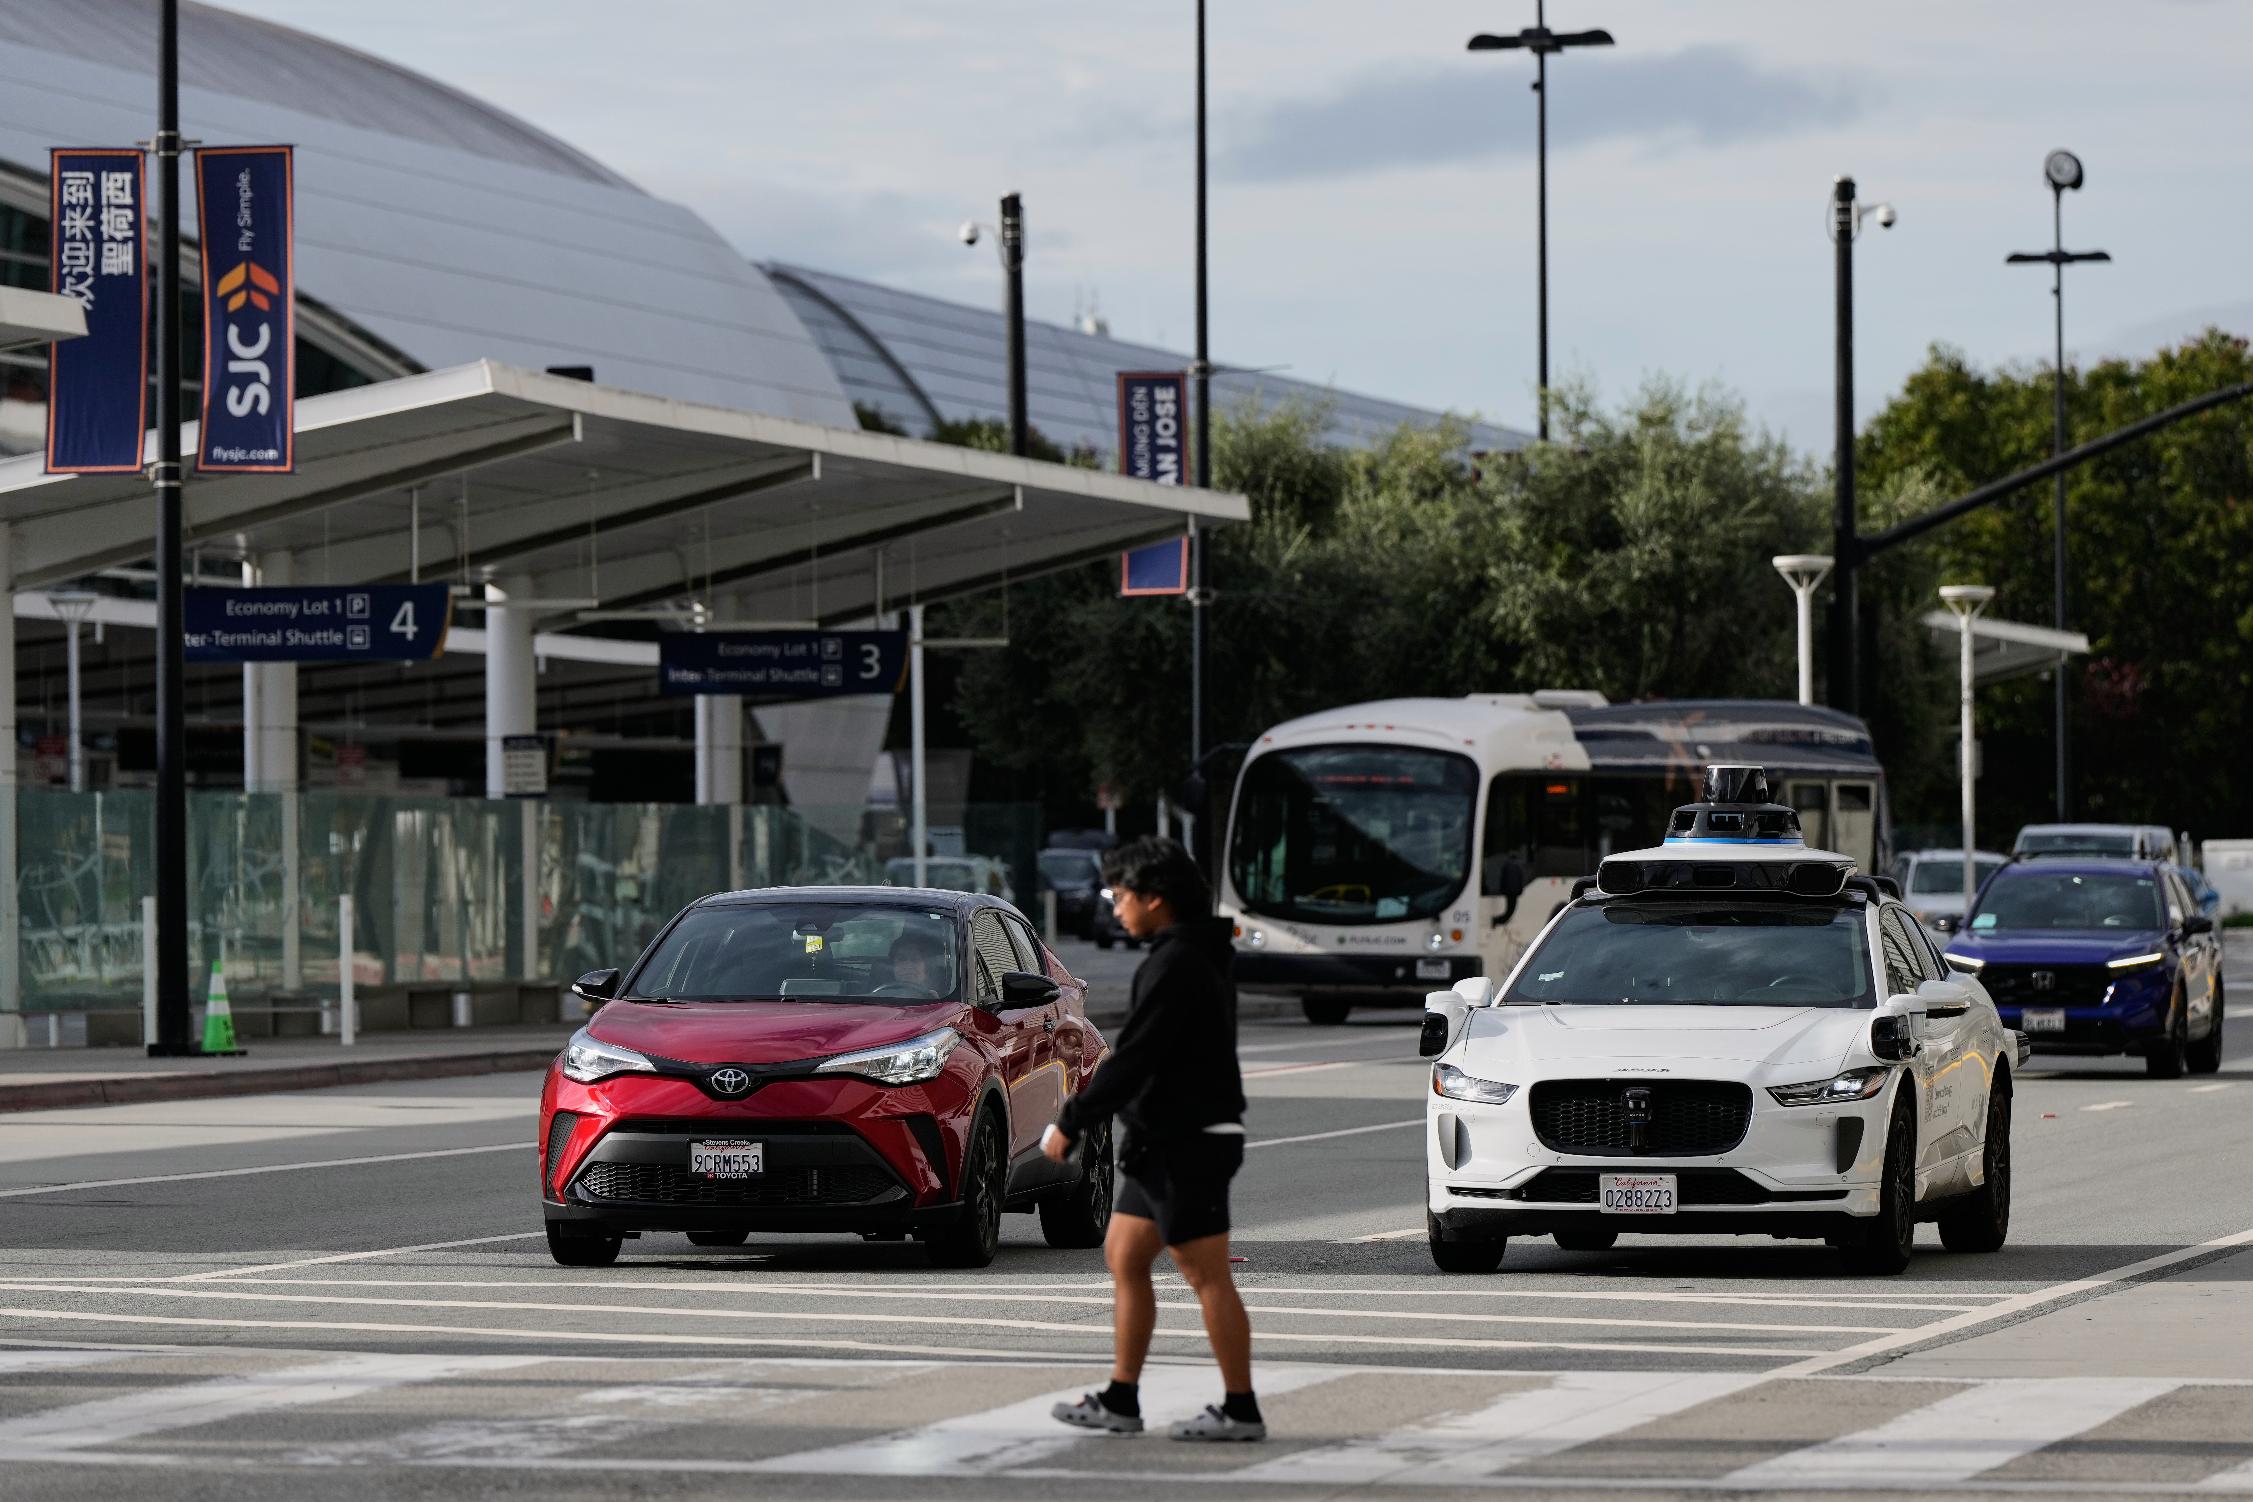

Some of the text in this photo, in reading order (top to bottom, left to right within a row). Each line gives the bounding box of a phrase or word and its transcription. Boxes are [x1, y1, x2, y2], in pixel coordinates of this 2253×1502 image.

[100, 170, 135, 276] 聖荷西
[61, 170, 96, 311] 欢迎来到
[238, 228, 255, 252] Fly
[226, 321, 271, 418] SJC
[1154, 386, 1178, 487] AN JOSE
[212, 446, 279, 462] flysjc.com
[226, 598, 299, 619] Economy
[303, 599, 329, 615] Lot
[335, 599, 342, 614] 1
[389, 601, 419, 641] 4
[184, 628, 345, 648] ter-Terminal Shuttle
[718, 641, 780, 659] Economy
[784, 641, 803, 656] Lot
[811, 642, 818, 656] 1
[858, 643, 882, 680] 3
[770, 667, 820, 682] Shuttle
[694, 1154, 760, 1172] 9CRM553
[1615, 1177, 1659, 1189] California
